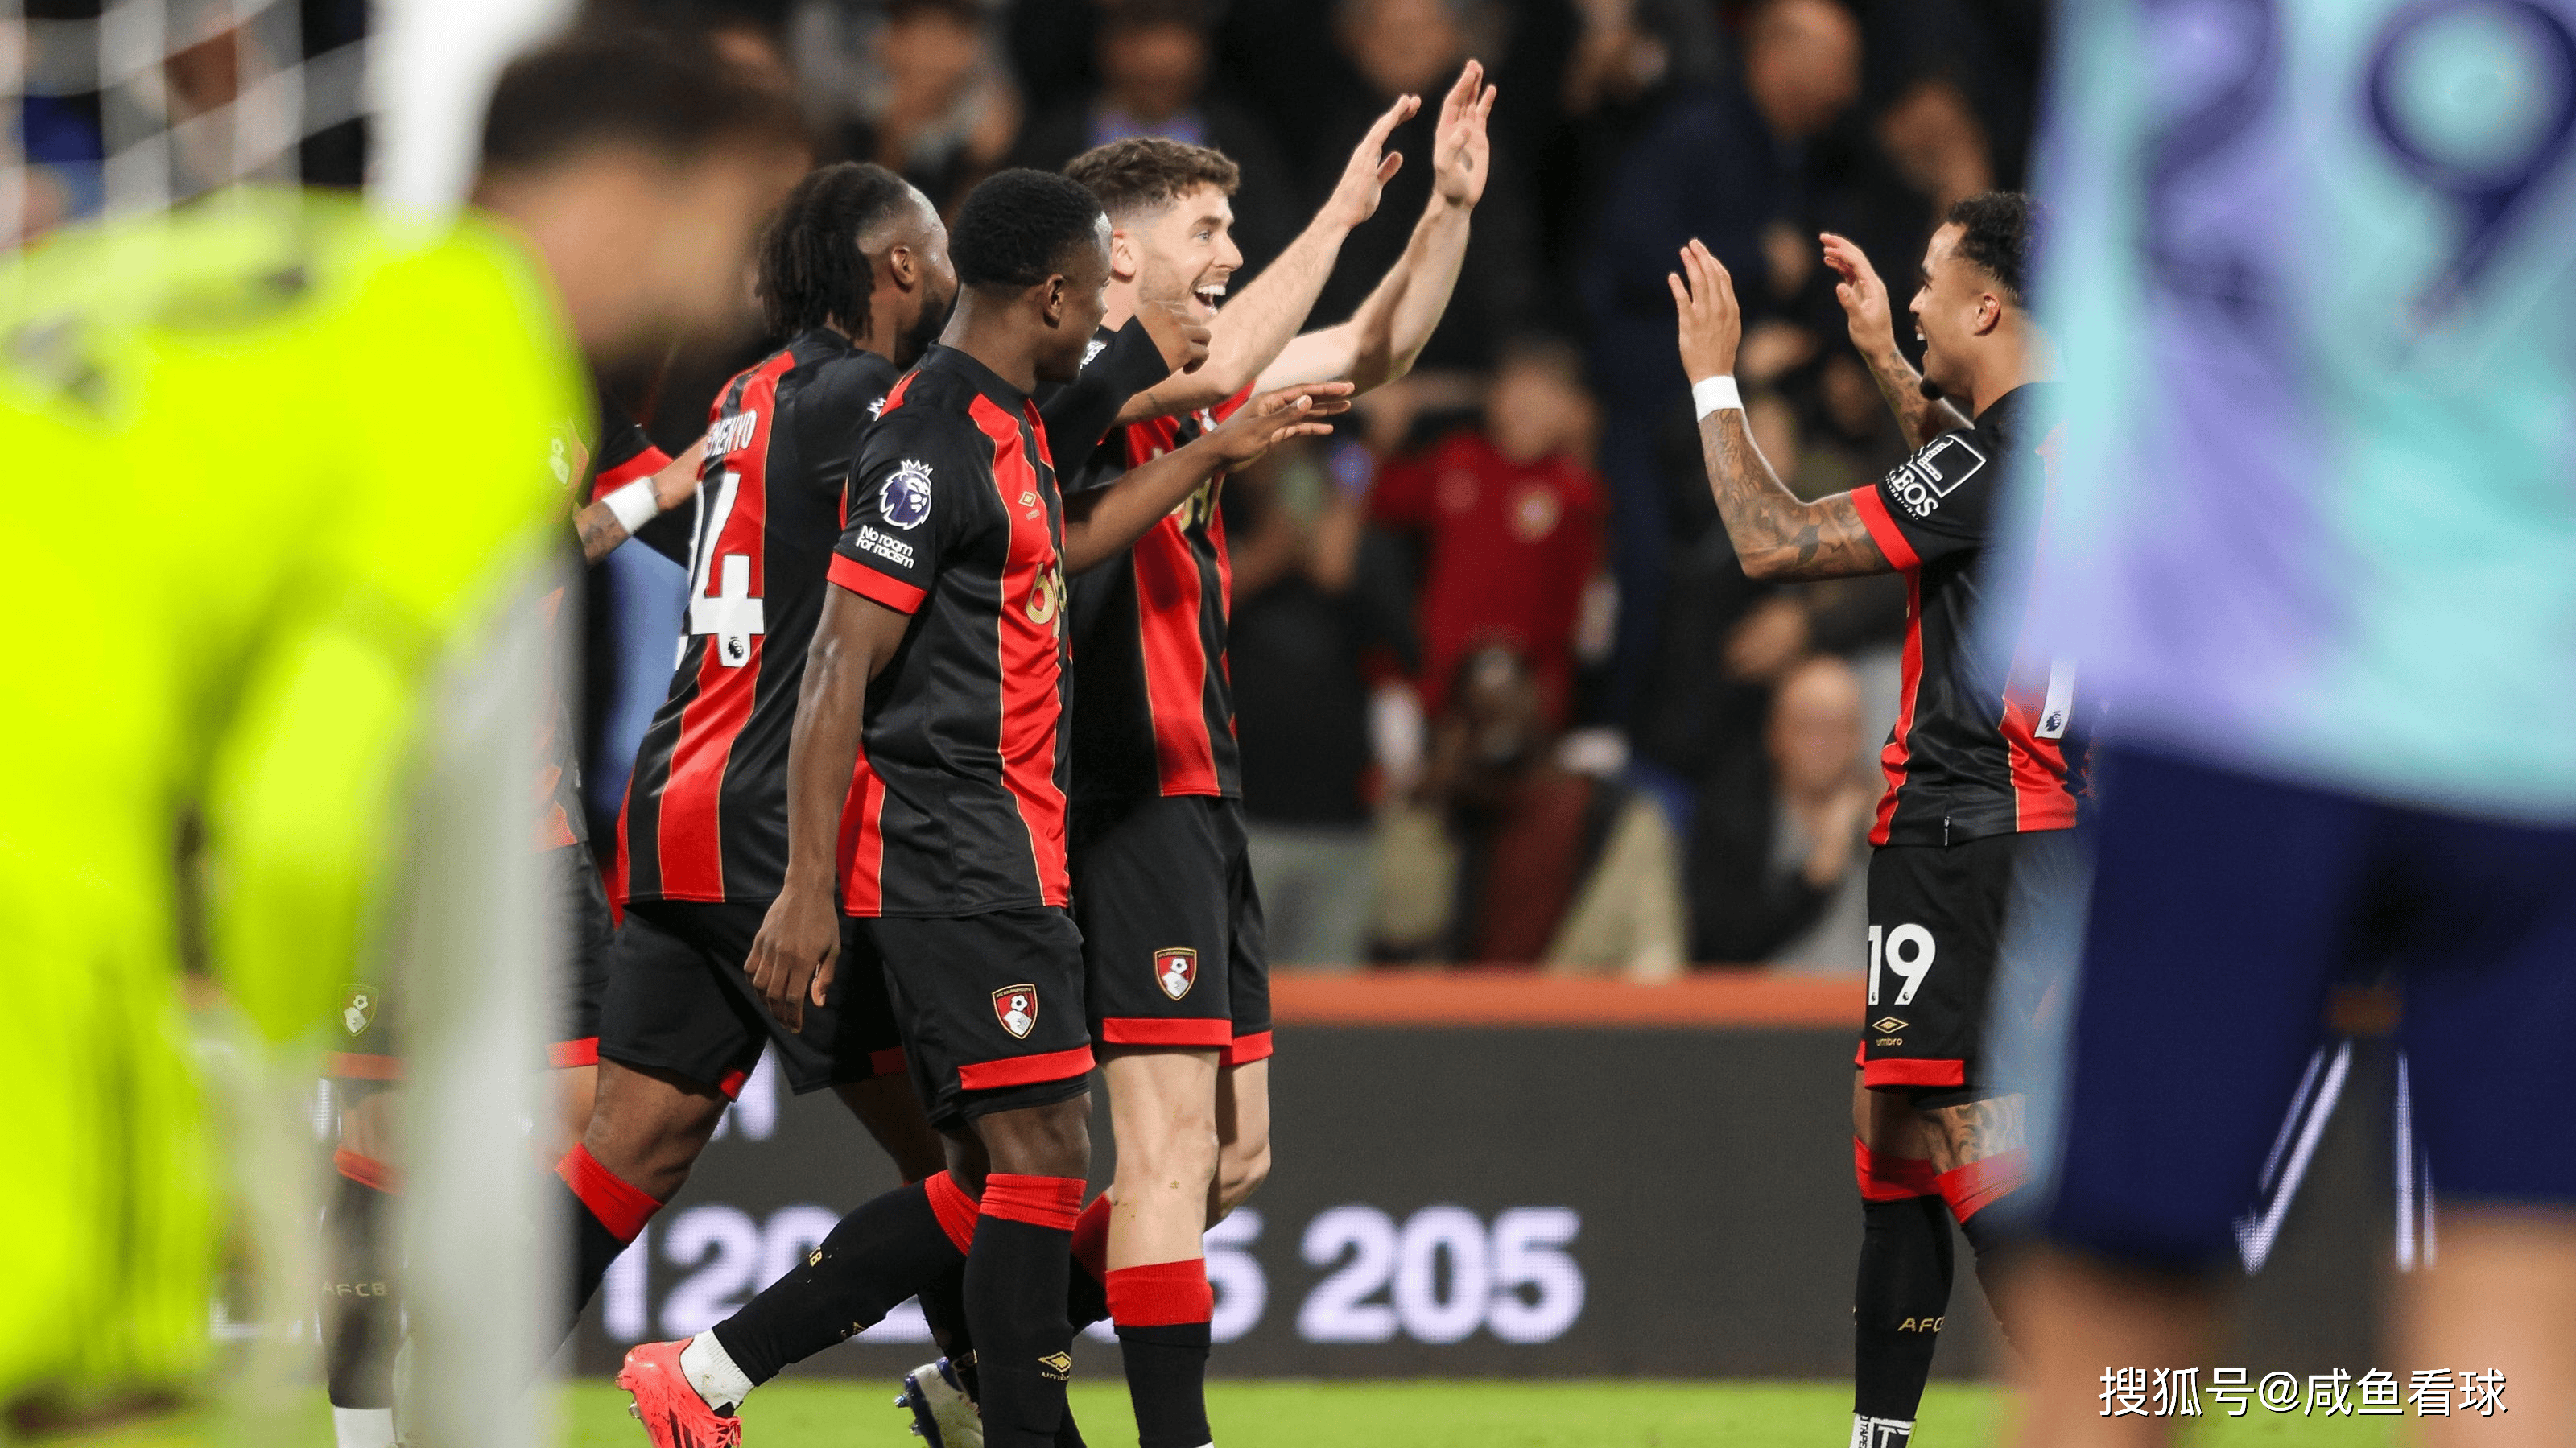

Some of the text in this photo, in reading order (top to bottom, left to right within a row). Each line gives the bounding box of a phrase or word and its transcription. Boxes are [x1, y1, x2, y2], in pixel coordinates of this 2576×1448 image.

[704, 410, 758, 457] EMENYO
[855, 535, 914, 569] for racism
[861, 524, 914, 557] No room
[675, 472, 766, 667] 4
[1868, 923, 1936, 1005] 19
[1876, 1037, 1903, 1046] umbro
[1294, 1205, 1586, 1343] 205
